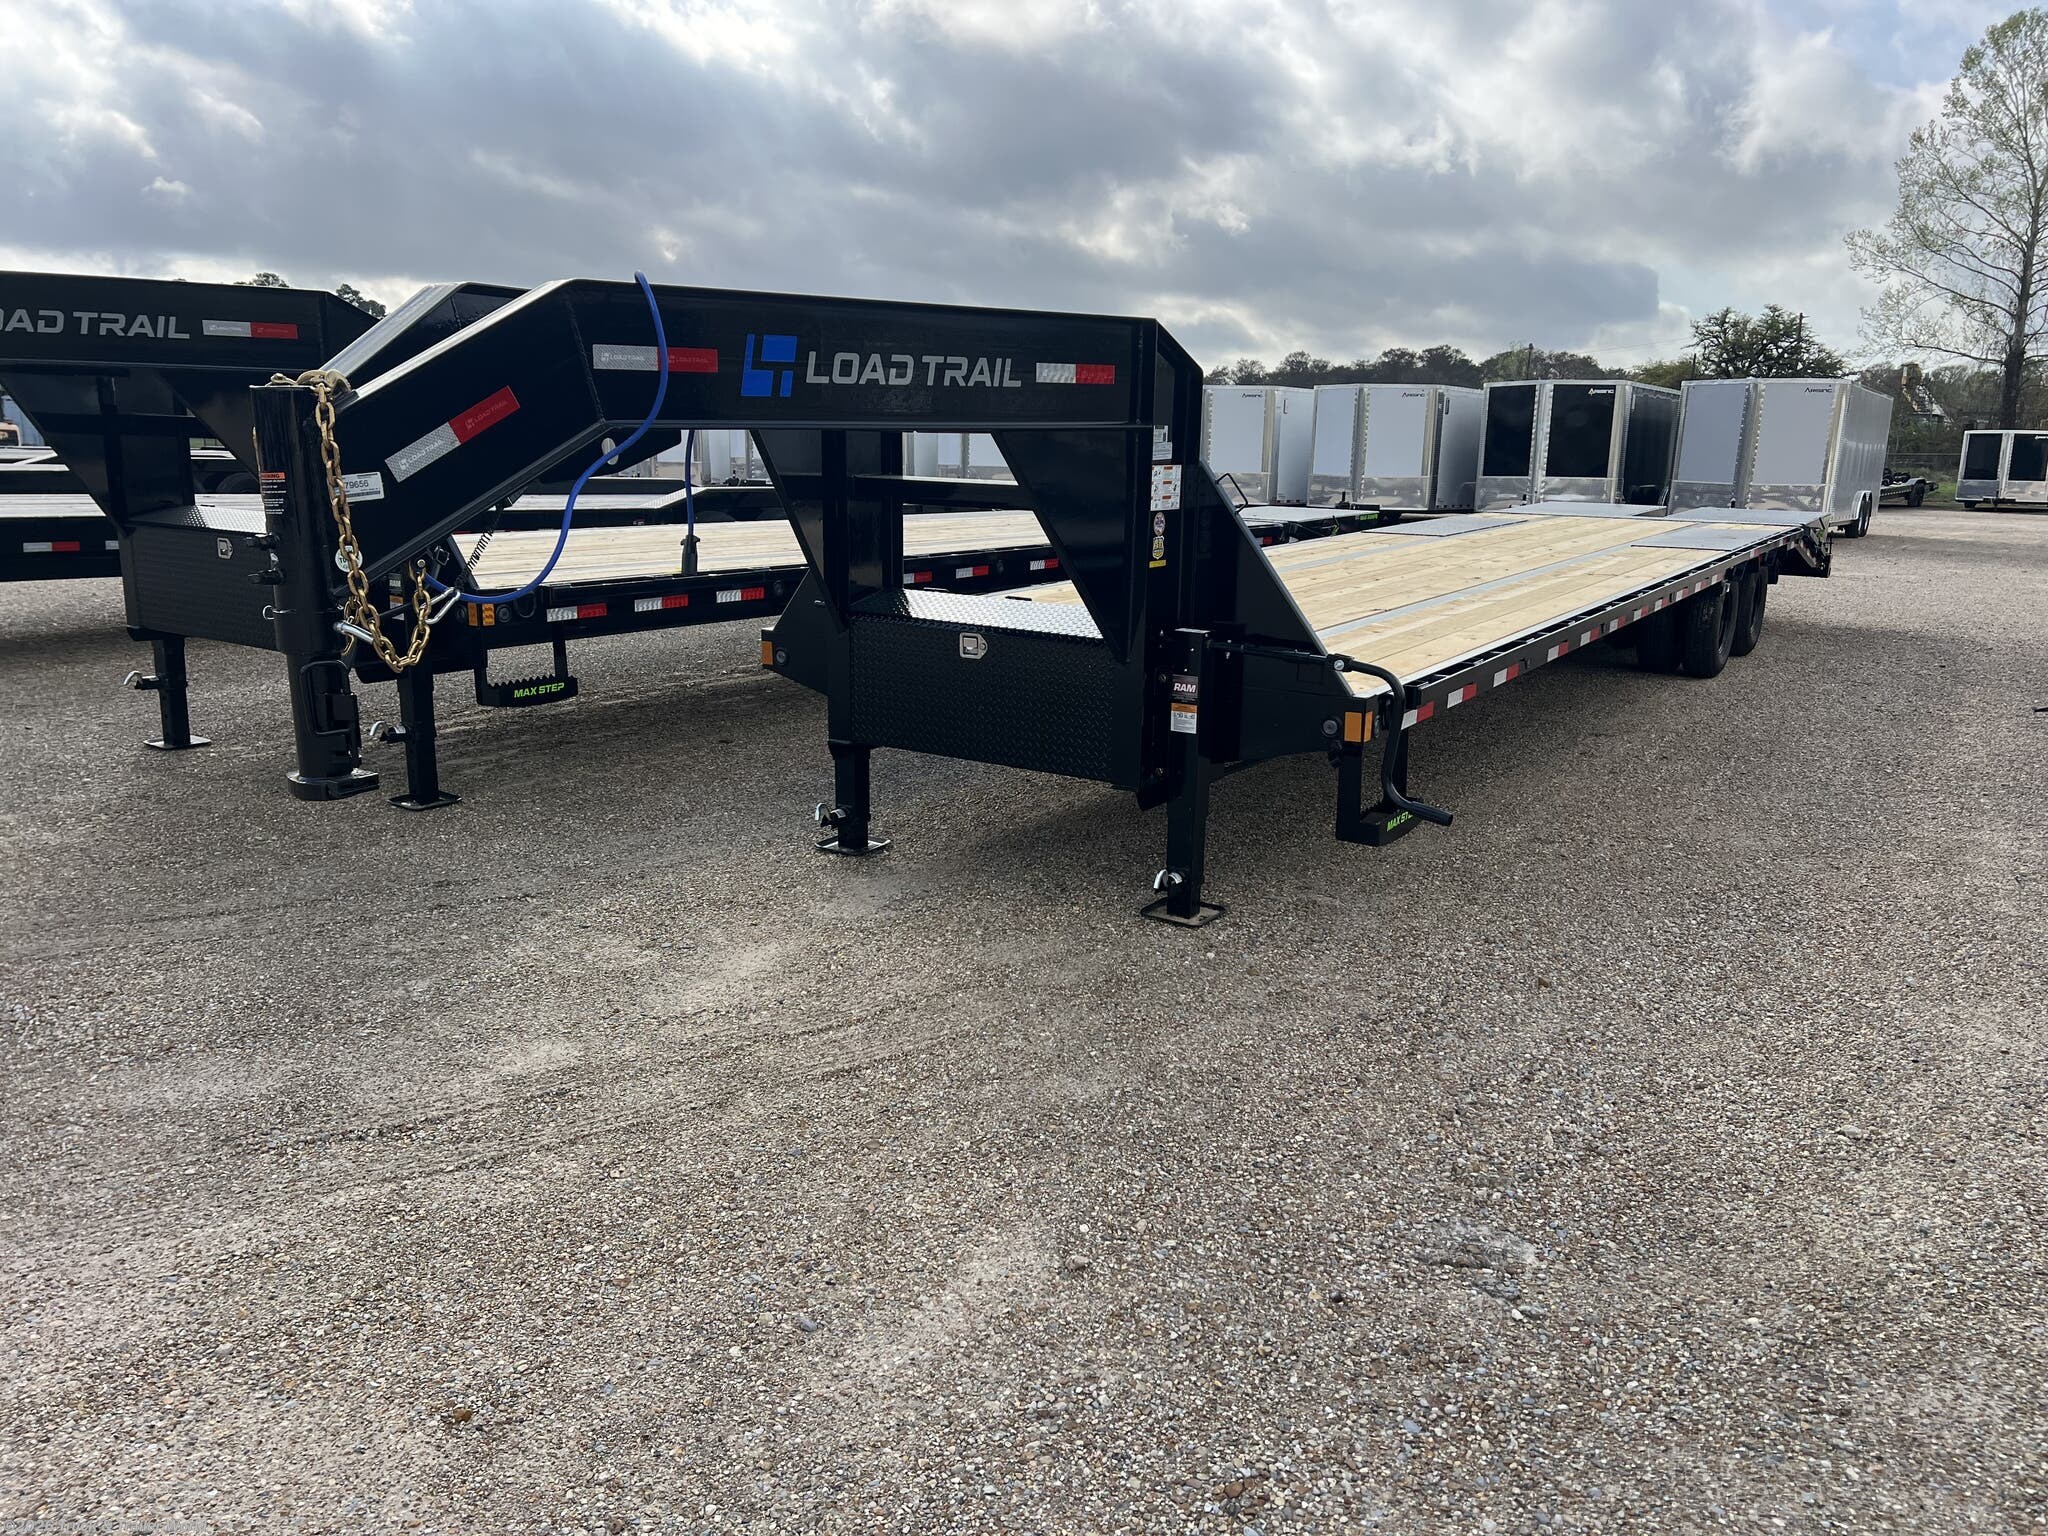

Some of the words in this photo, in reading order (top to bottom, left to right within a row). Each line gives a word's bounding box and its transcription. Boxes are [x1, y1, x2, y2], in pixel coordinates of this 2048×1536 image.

[0, 308, 64, 334] AD
[73, 311, 190, 339] TRAIL
[806, 351, 914, 386] LOAD
[922, 355, 1022, 388] TRAIL
[514, 686, 538, 698] MAX
[538, 682, 565, 694] STEP
[1173, 682, 1197, 693] RAM
